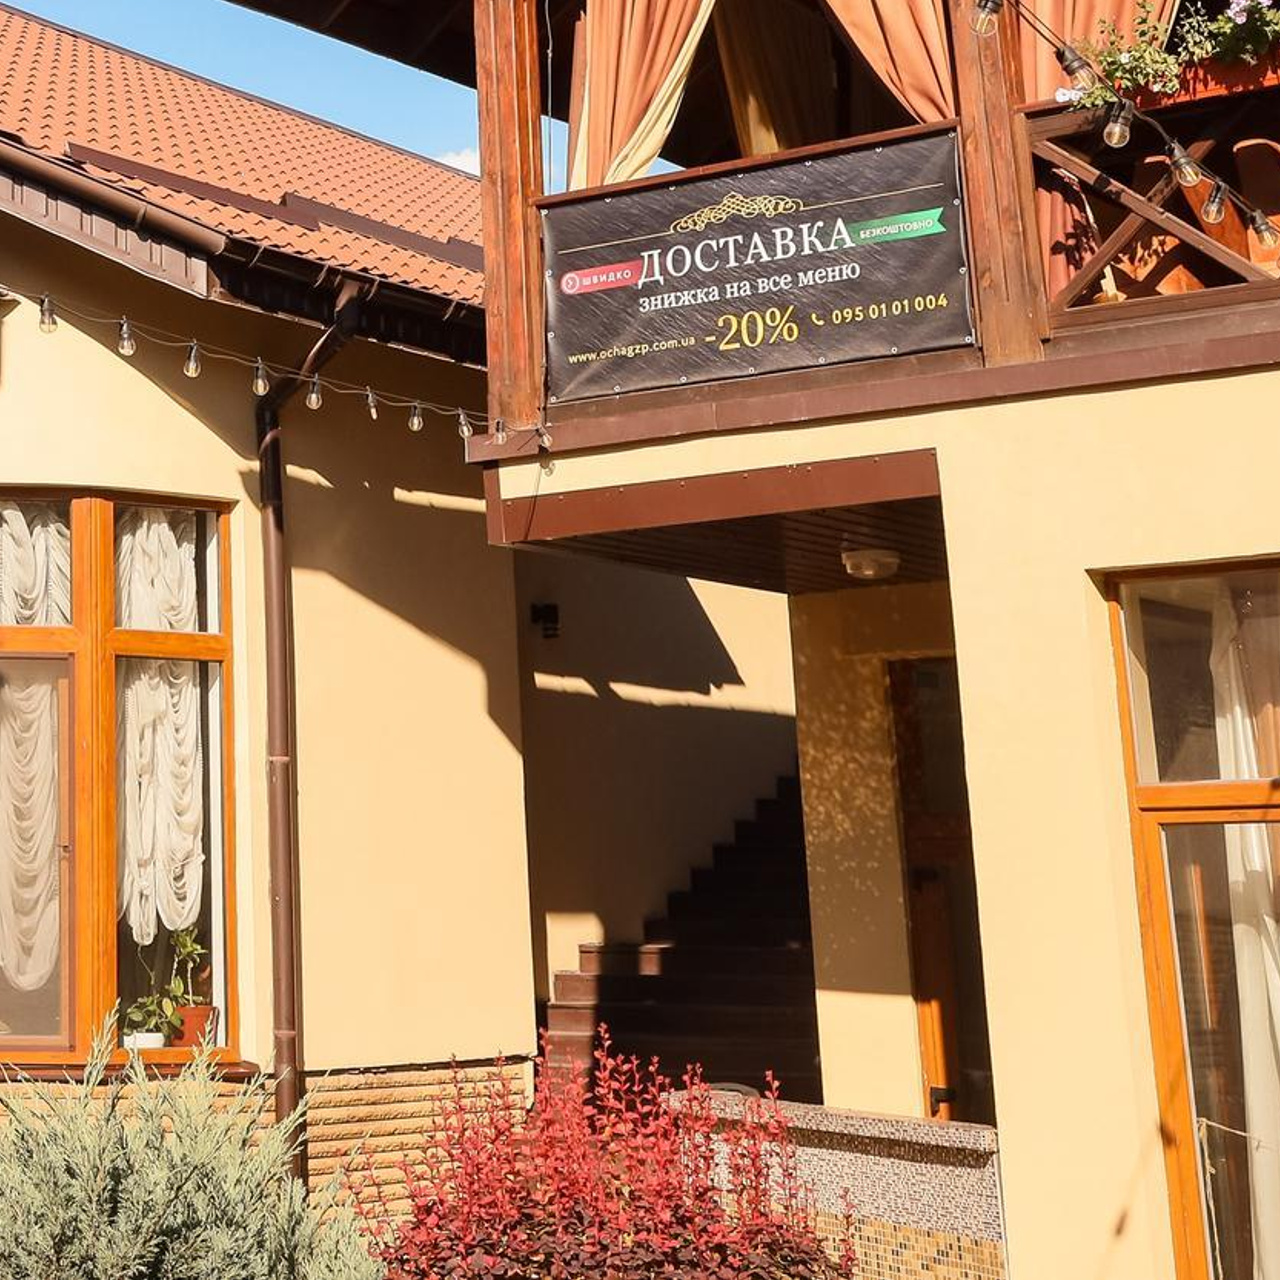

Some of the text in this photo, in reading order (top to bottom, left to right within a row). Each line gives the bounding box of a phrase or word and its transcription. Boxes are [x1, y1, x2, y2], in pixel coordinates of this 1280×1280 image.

[859, 218, 934, 240] БЕЗКОШТОВНО
[637, 217, 856, 290] ДОСТАВКА
[582, 269, 632, 286] ШВИДКО
[638, 262, 861, 313] знижка на все меню
[831, 293, 949, 325] 095 01 01 004
[704, 305, 800, 351] -20%
[568, 336, 696, 365] www.ochagzp.com.ua
